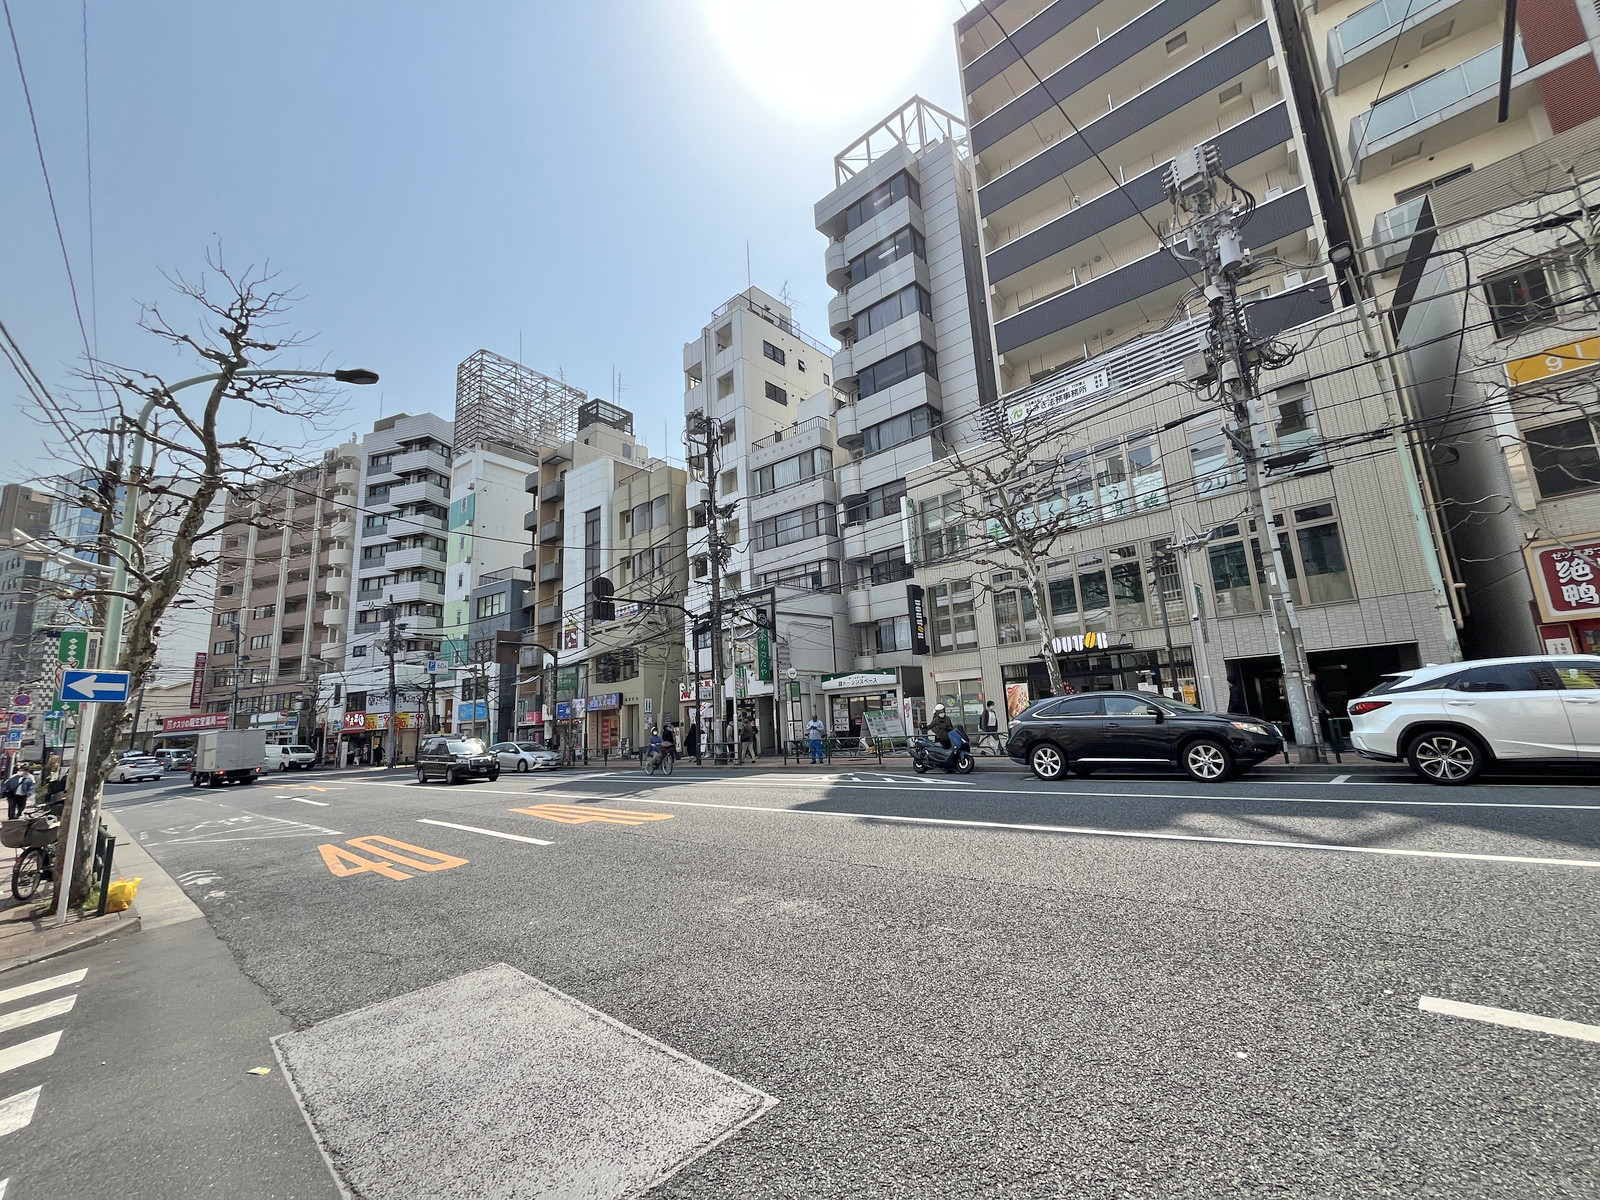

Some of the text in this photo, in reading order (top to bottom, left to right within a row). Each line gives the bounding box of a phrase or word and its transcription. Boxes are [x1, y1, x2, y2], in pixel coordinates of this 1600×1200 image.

[914, 598, 925, 639] DOUTOR
[1051, 631, 1108, 653] OUTOR
[508, 803, 676, 825] 40
[316, 834, 470, 881] 40
